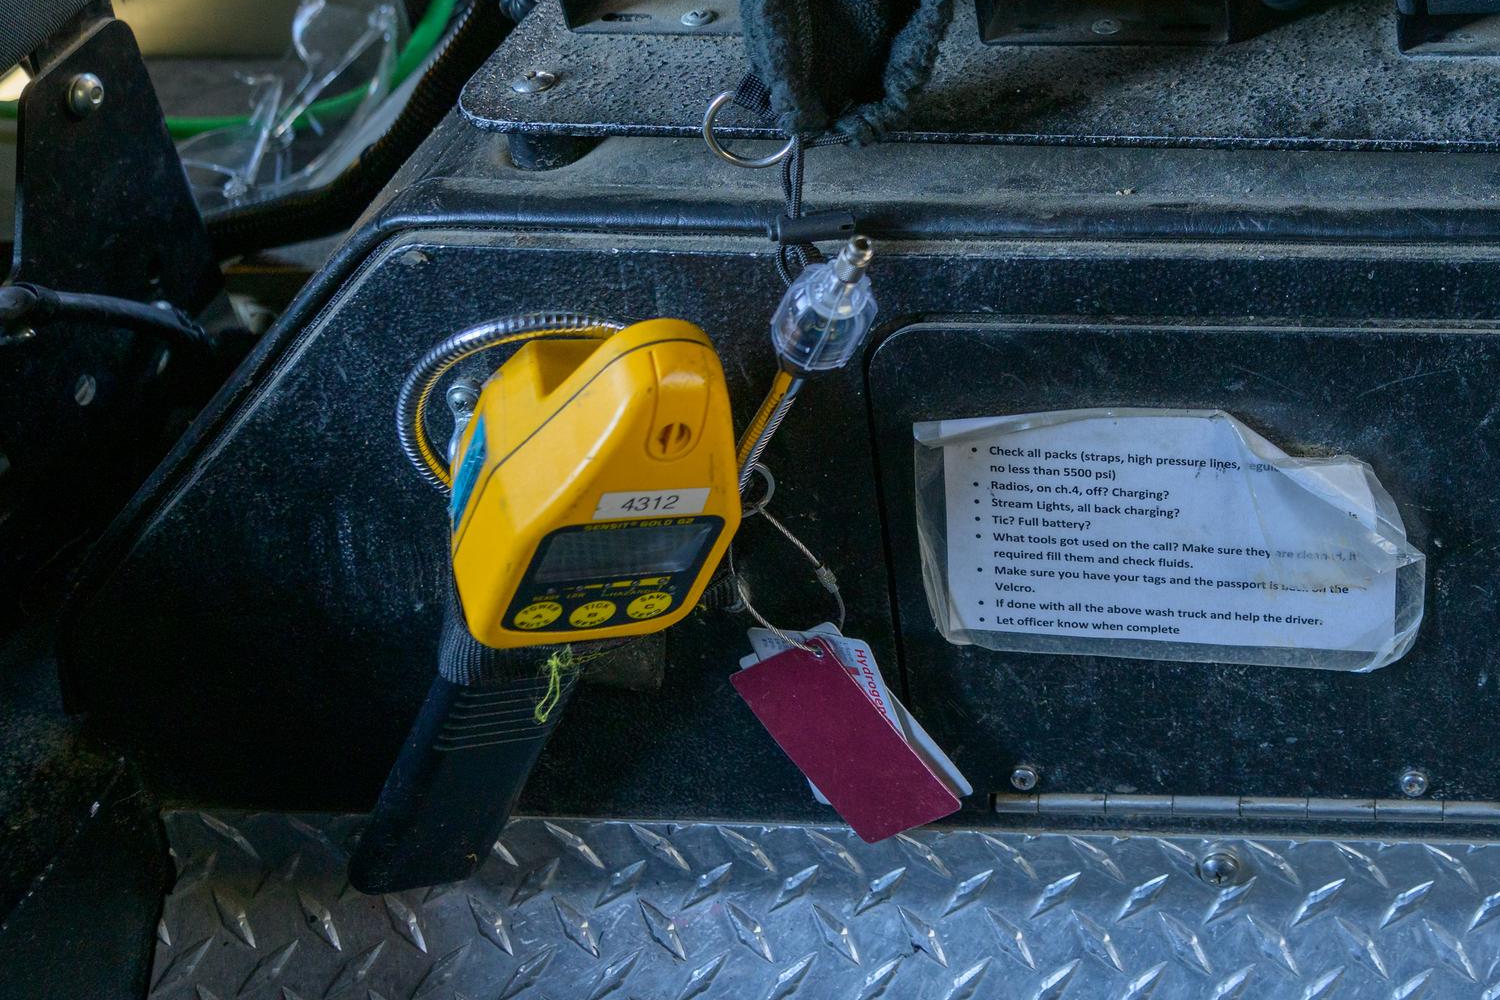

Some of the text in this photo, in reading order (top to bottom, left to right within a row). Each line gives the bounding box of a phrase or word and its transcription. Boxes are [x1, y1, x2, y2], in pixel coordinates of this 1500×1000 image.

[989, 446, 1024, 457] Check
[1027, 449, 1041, 458] all
[1044, 450, 1077, 462] packs
[1081, 451, 1124, 464] (straps,
[1127, 454, 1152, 466] high
[1156, 457, 1206, 468] pressure
[1210, 458, 1240, 470] lines,
[990, 464, 1116, 481] no less than 5500 psi)
[991, 481, 1169, 501] Radios, on ch.4, off? Charging?
[621, 495, 680, 512] 4312
[992, 498, 1180, 519] Stream Lights, all back charging?
[992, 515, 1091, 531] Tic? Full battery?
[993, 532, 1025, 543] What
[1028, 535, 1056, 545] tools
[1060, 537, 1079, 547] got
[1082, 537, 1109, 548] used
[1113, 540, 1127, 549] on
[1131, 540, 1149, 550] the
[1153, 541, 1179, 552] call?
[1182, 543, 1214, 554] Make
[1217, 545, 1242, 556] sure
[1246, 546, 1271, 559] they
[994, 550, 1193, 569] required fill them and check fluids.
[995, 566, 1027, 577] Make
[1030, 569, 1055, 578] sure
[1058, 570, 1079, 580] you
[1083, 570, 1111, 580] have
[1114, 573, 1140, 583] your
[1143, 574, 1166, 585] tags
[1169, 576, 1191, 586] and
[1194, 577, 1213, 587] the
[1217, 579, 1266, 591] passport
[1269, 581, 1278, 590] is
[995, 582, 1035, 593] Velcro.
[996, 599, 1323, 626] If done with all the above wash truck and help the driver.
[997, 616, 1180, 635] Let officer know when complete
[855, 649, 887, 715] Hydrogen
